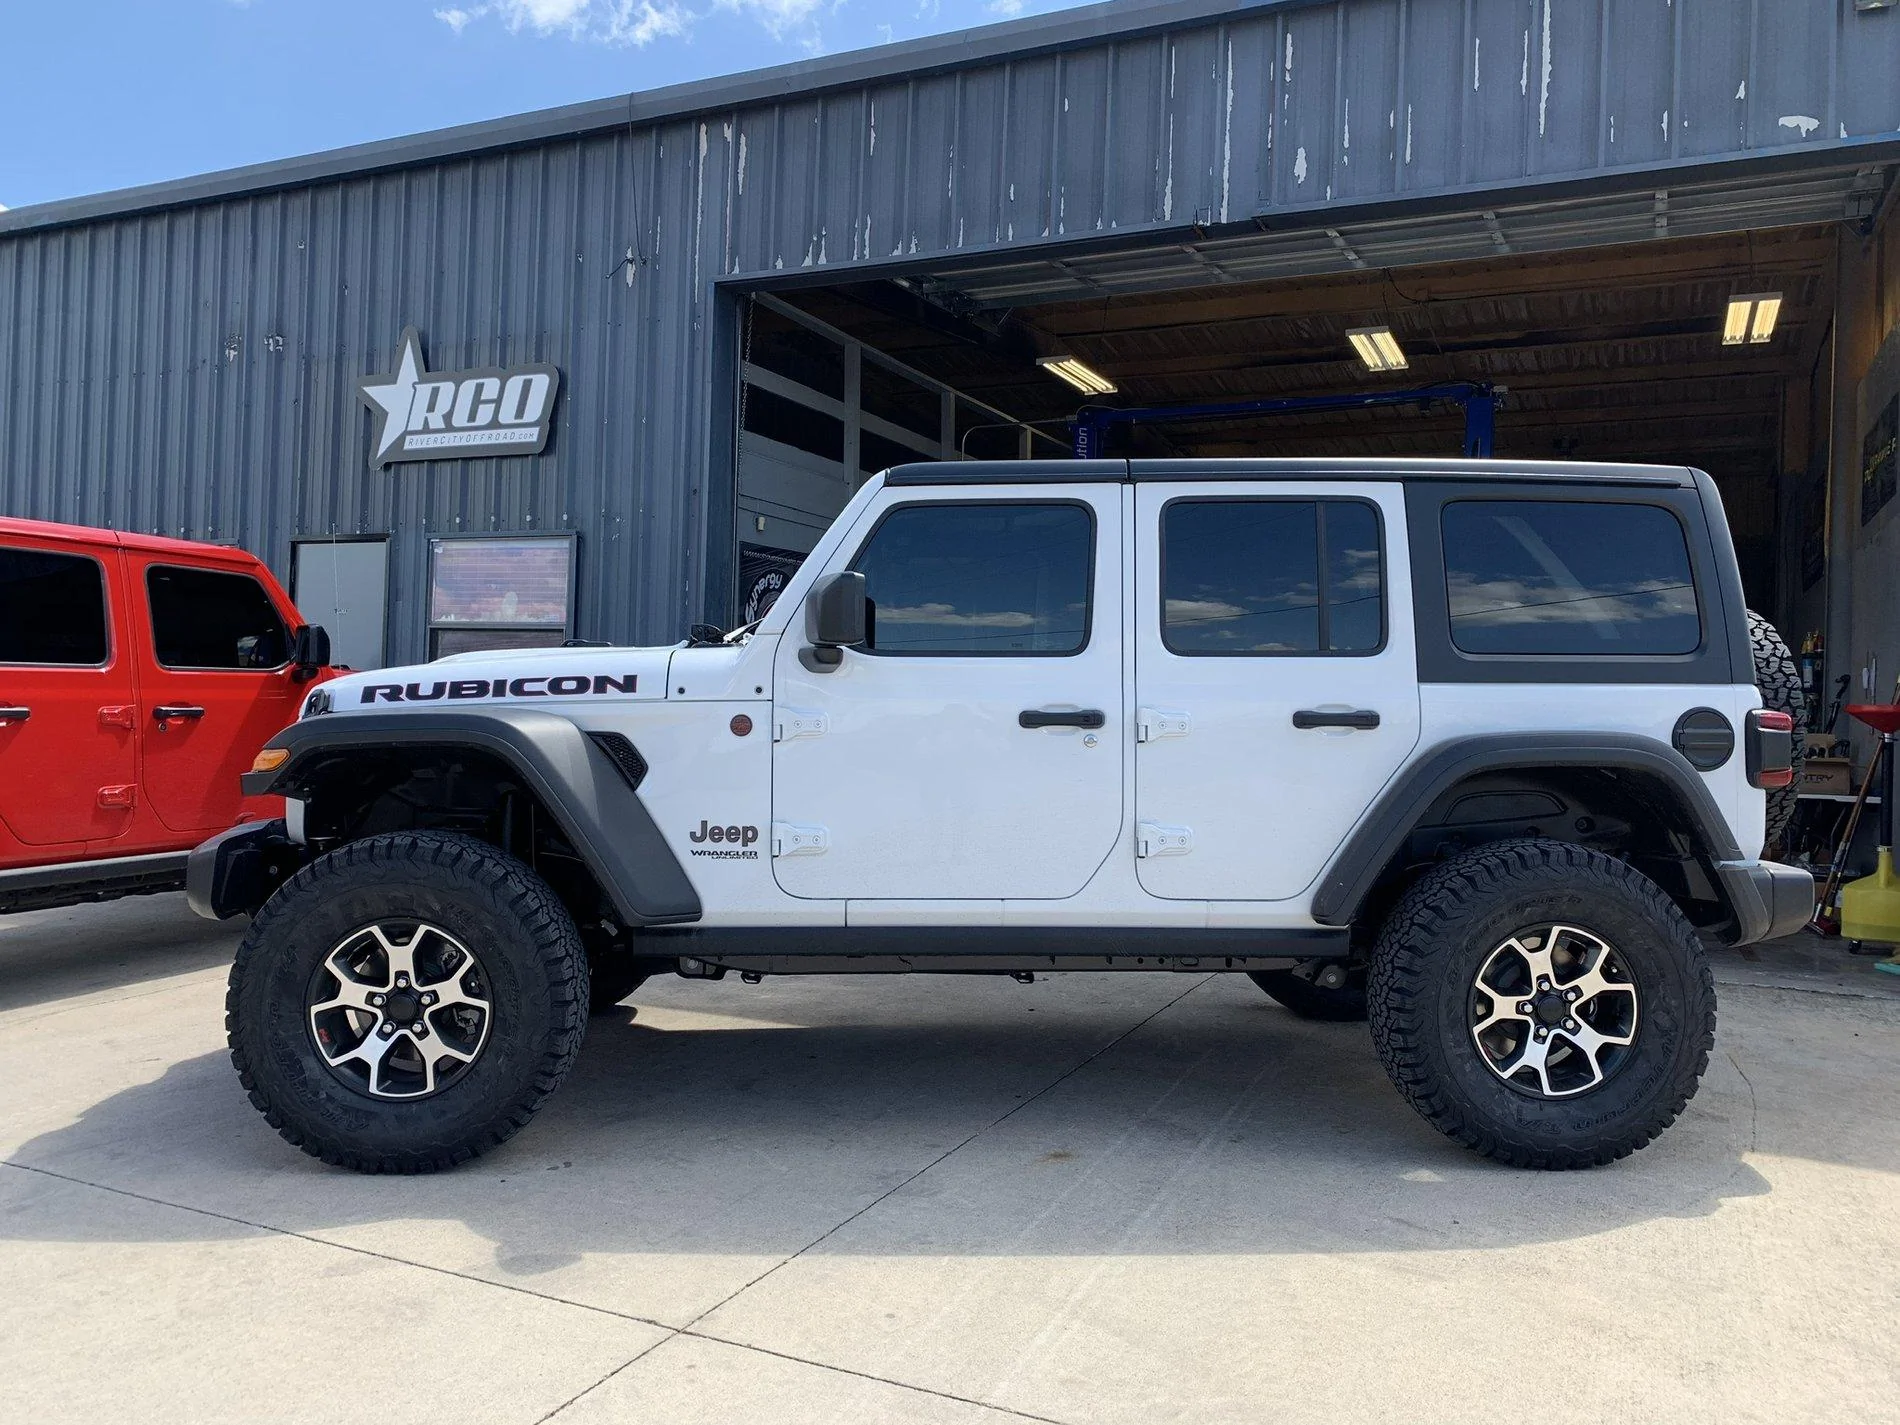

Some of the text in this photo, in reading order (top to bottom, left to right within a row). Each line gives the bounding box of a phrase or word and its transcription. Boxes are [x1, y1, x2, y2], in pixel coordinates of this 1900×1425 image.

[407, 373, 549, 431] RCO
[360, 674, 638, 704] RUBICON
[689, 820, 758, 847] Jeep
